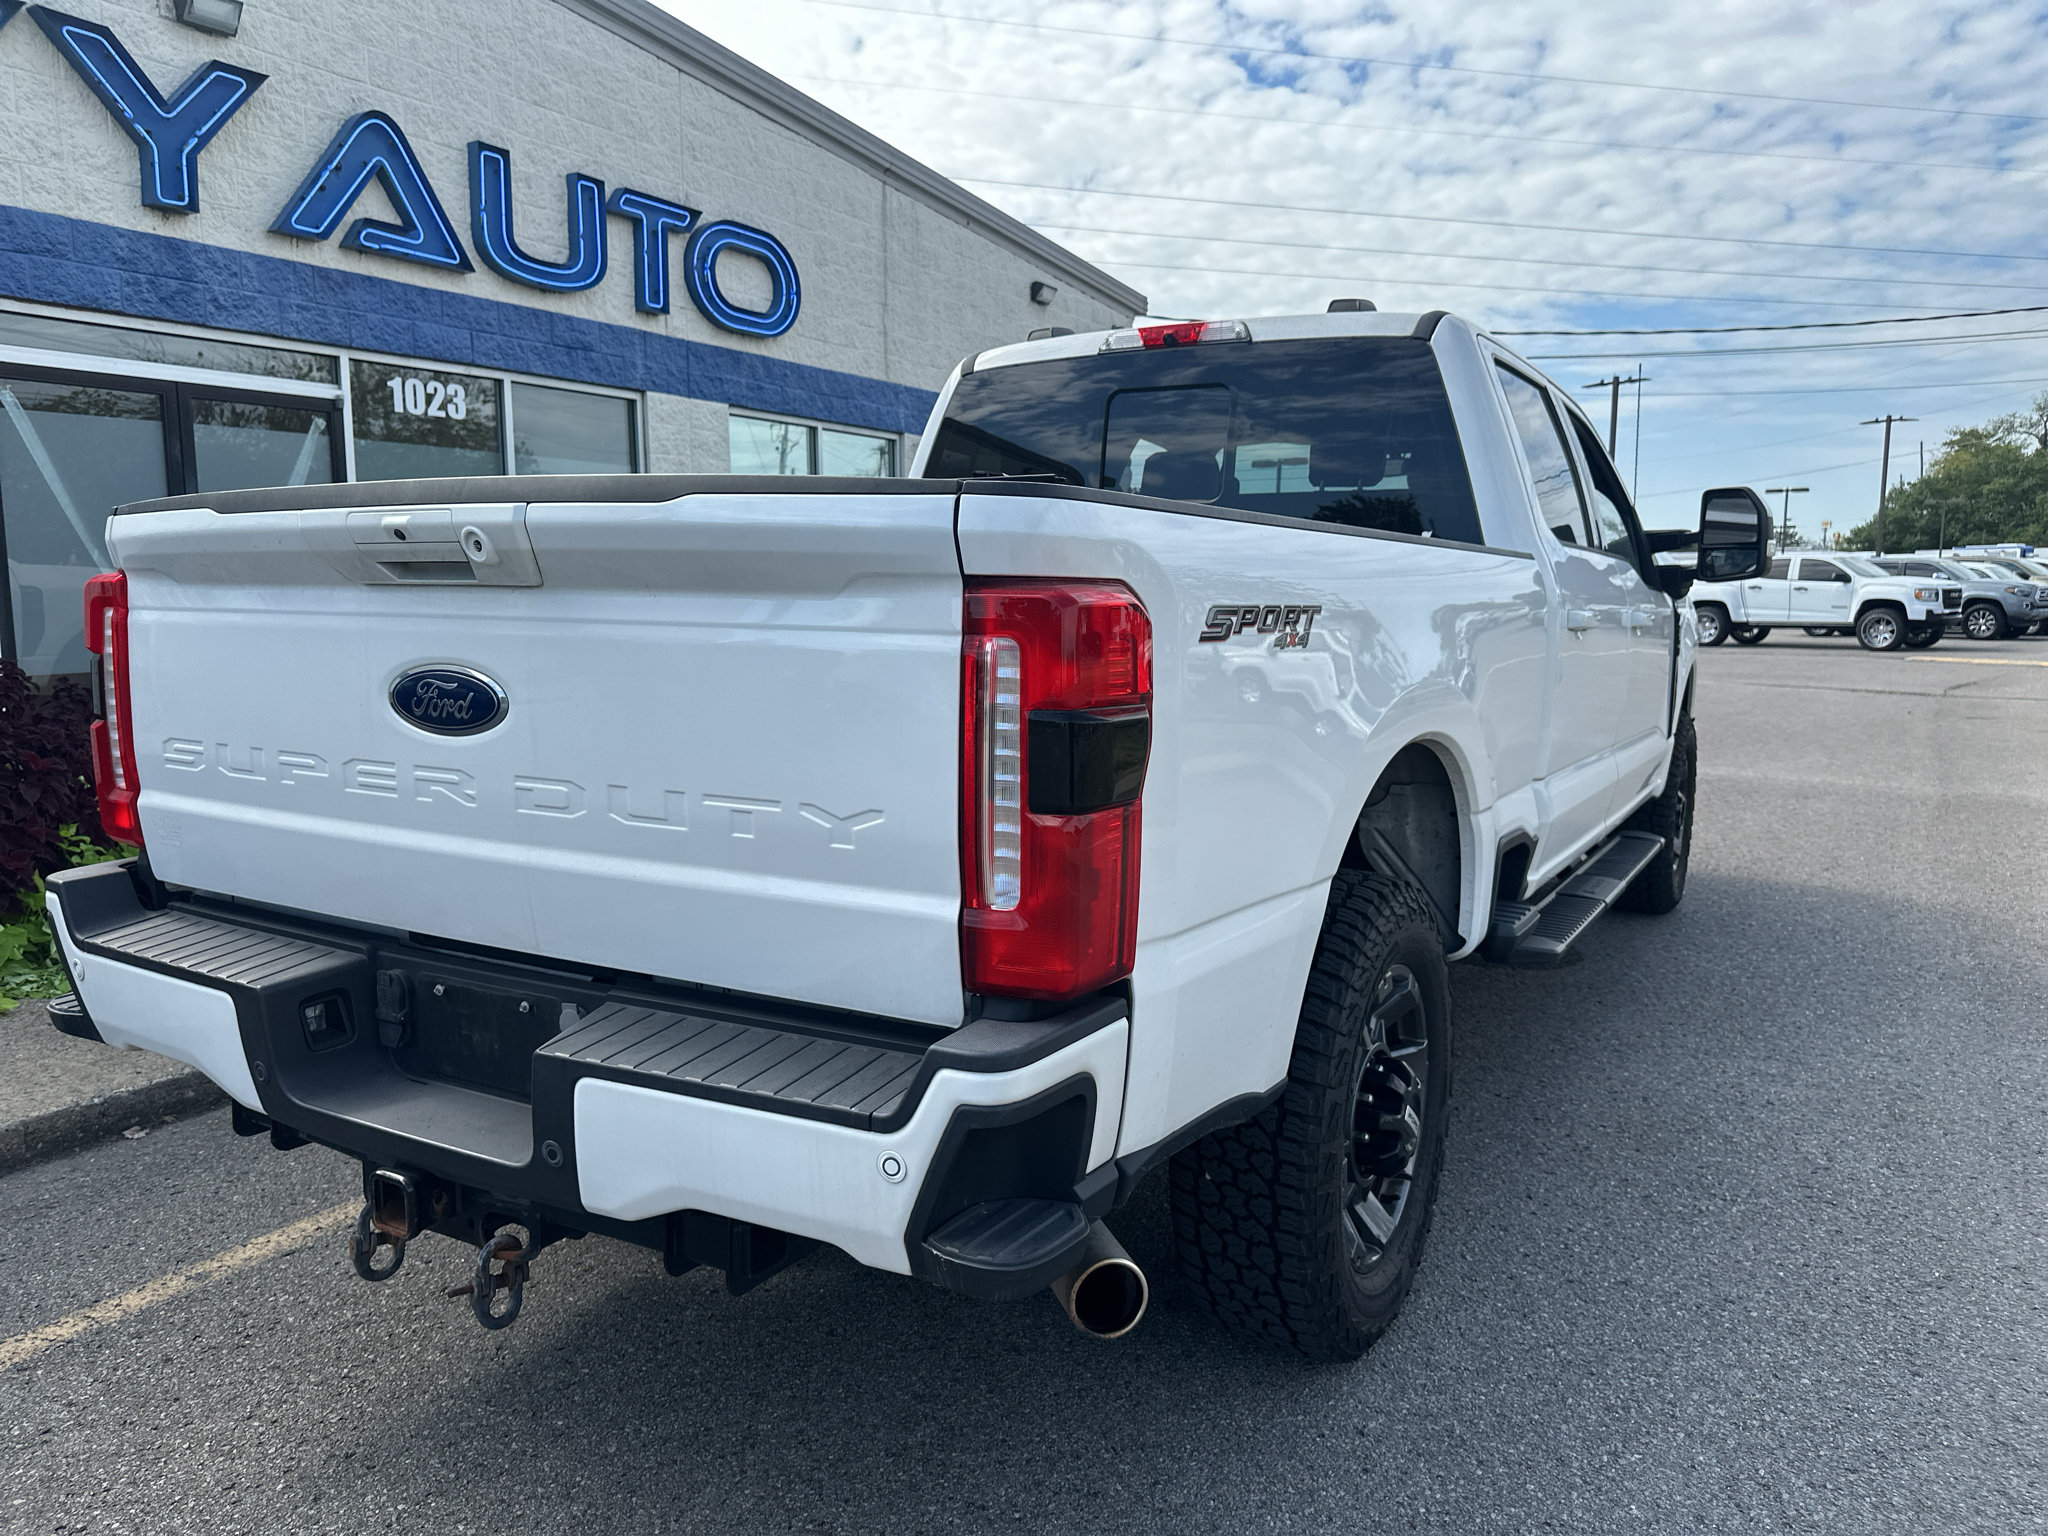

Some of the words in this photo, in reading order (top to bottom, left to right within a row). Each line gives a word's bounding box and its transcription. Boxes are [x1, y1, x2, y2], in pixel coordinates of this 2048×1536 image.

[0, 1, 270, 214] Y
[267, 109, 801, 338] AUTO
[386, 375, 467, 420] 1023
[1198, 605, 1323, 643] SPORT
[411, 678, 475, 720] Ford
[162, 736, 477, 808] SUPER
[513, 774, 885, 850] DUTY
